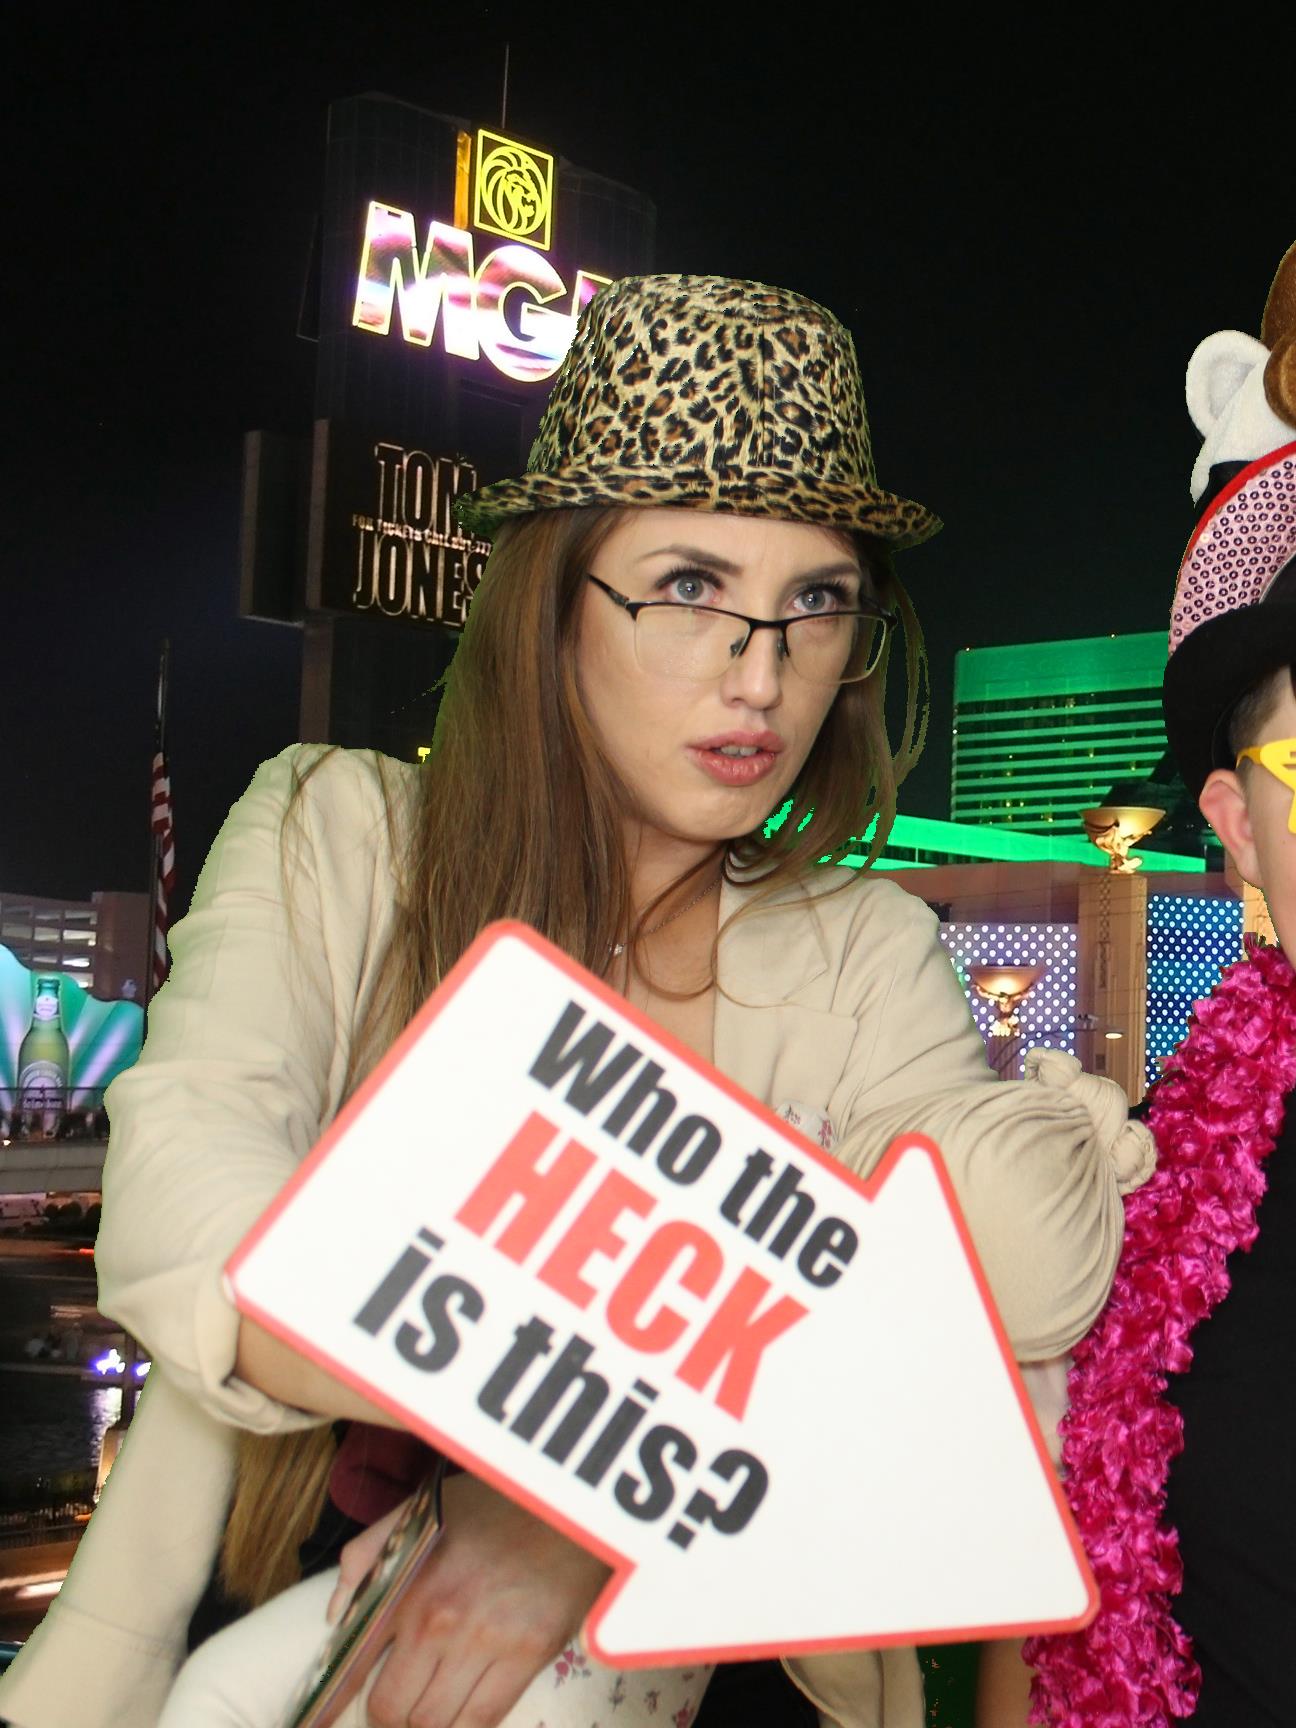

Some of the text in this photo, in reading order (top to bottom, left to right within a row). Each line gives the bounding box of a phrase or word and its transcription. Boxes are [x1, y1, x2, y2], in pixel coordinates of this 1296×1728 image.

[352, 201, 612, 383] MG
[453, 1110, 809, 1423] HECK
[529, 1000, 859, 1290] Who the
[352, 1227, 770, 1551] is this?
